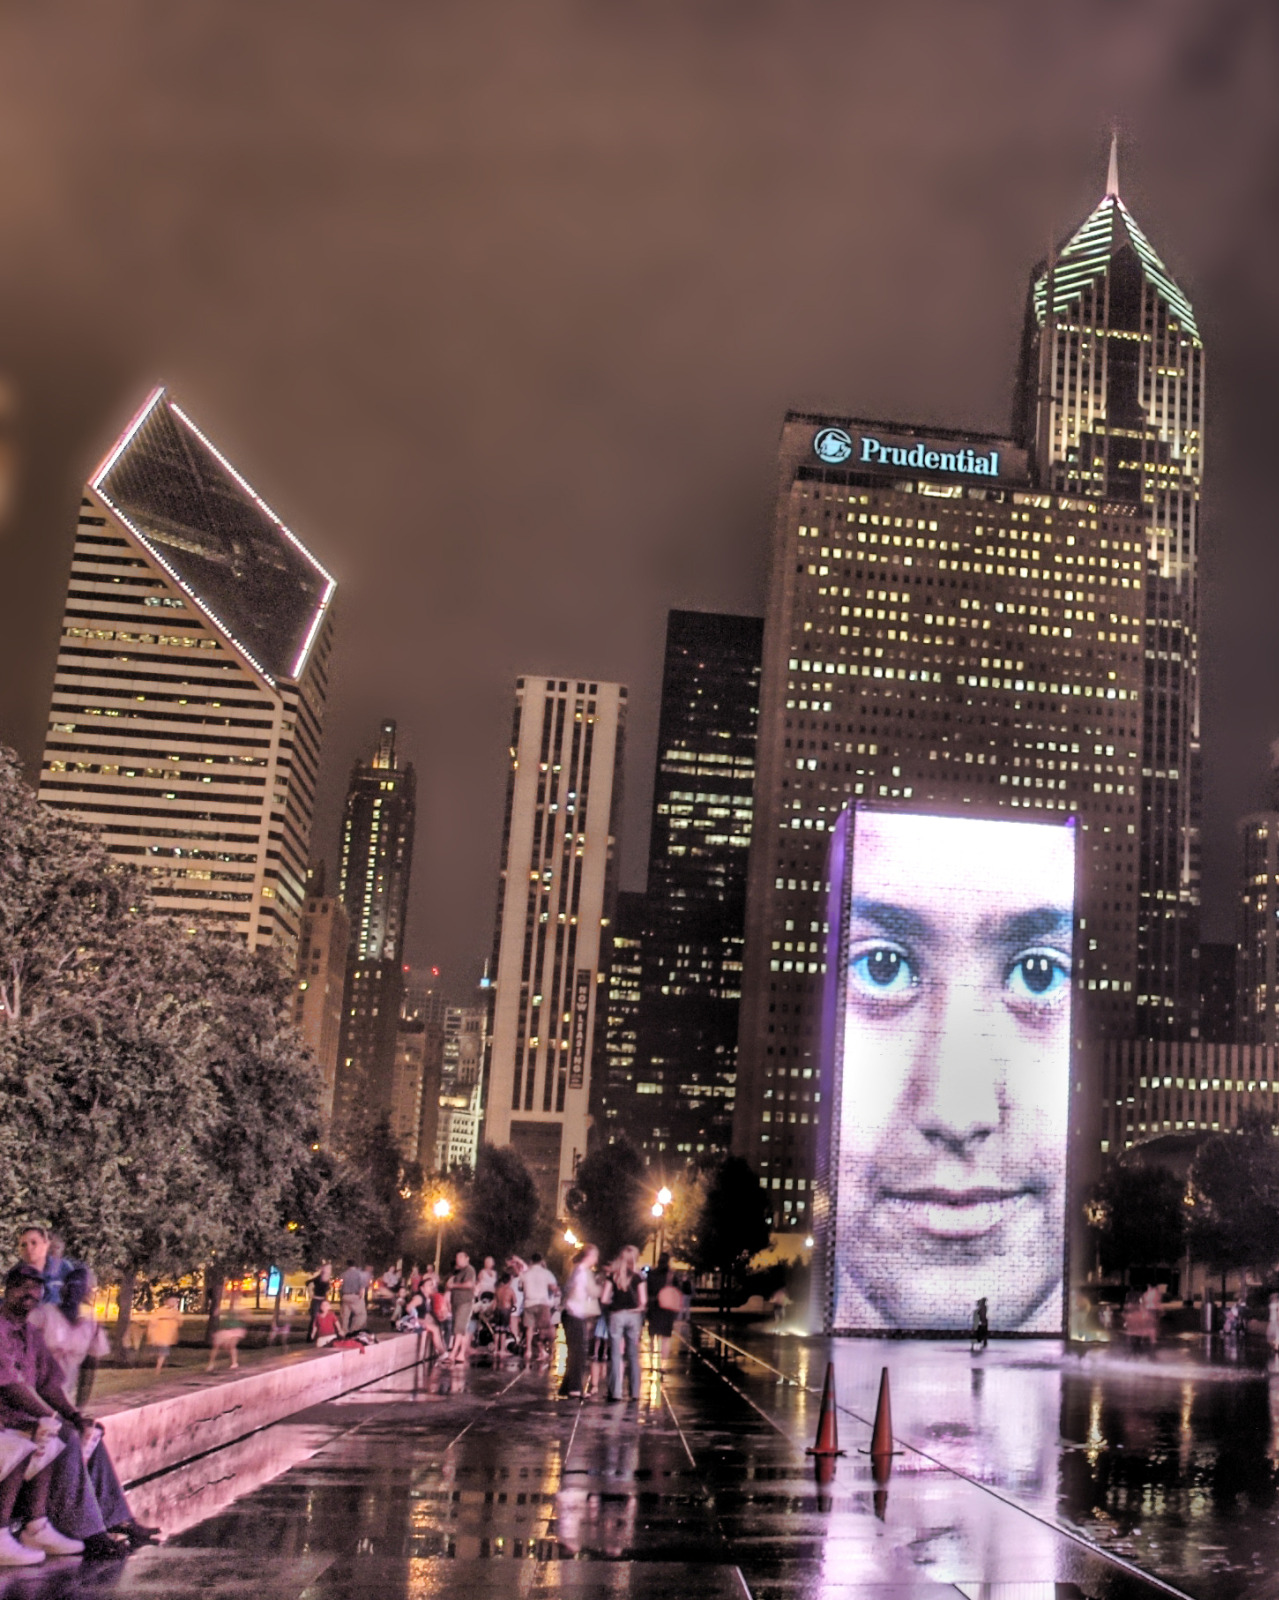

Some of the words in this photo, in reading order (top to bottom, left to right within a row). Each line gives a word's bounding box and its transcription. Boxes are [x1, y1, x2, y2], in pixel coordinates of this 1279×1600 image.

[860, 437, 999, 477] Prudential
[577, 986, 588, 1012] NOW
[573, 1014, 584, 1073] LEASING
